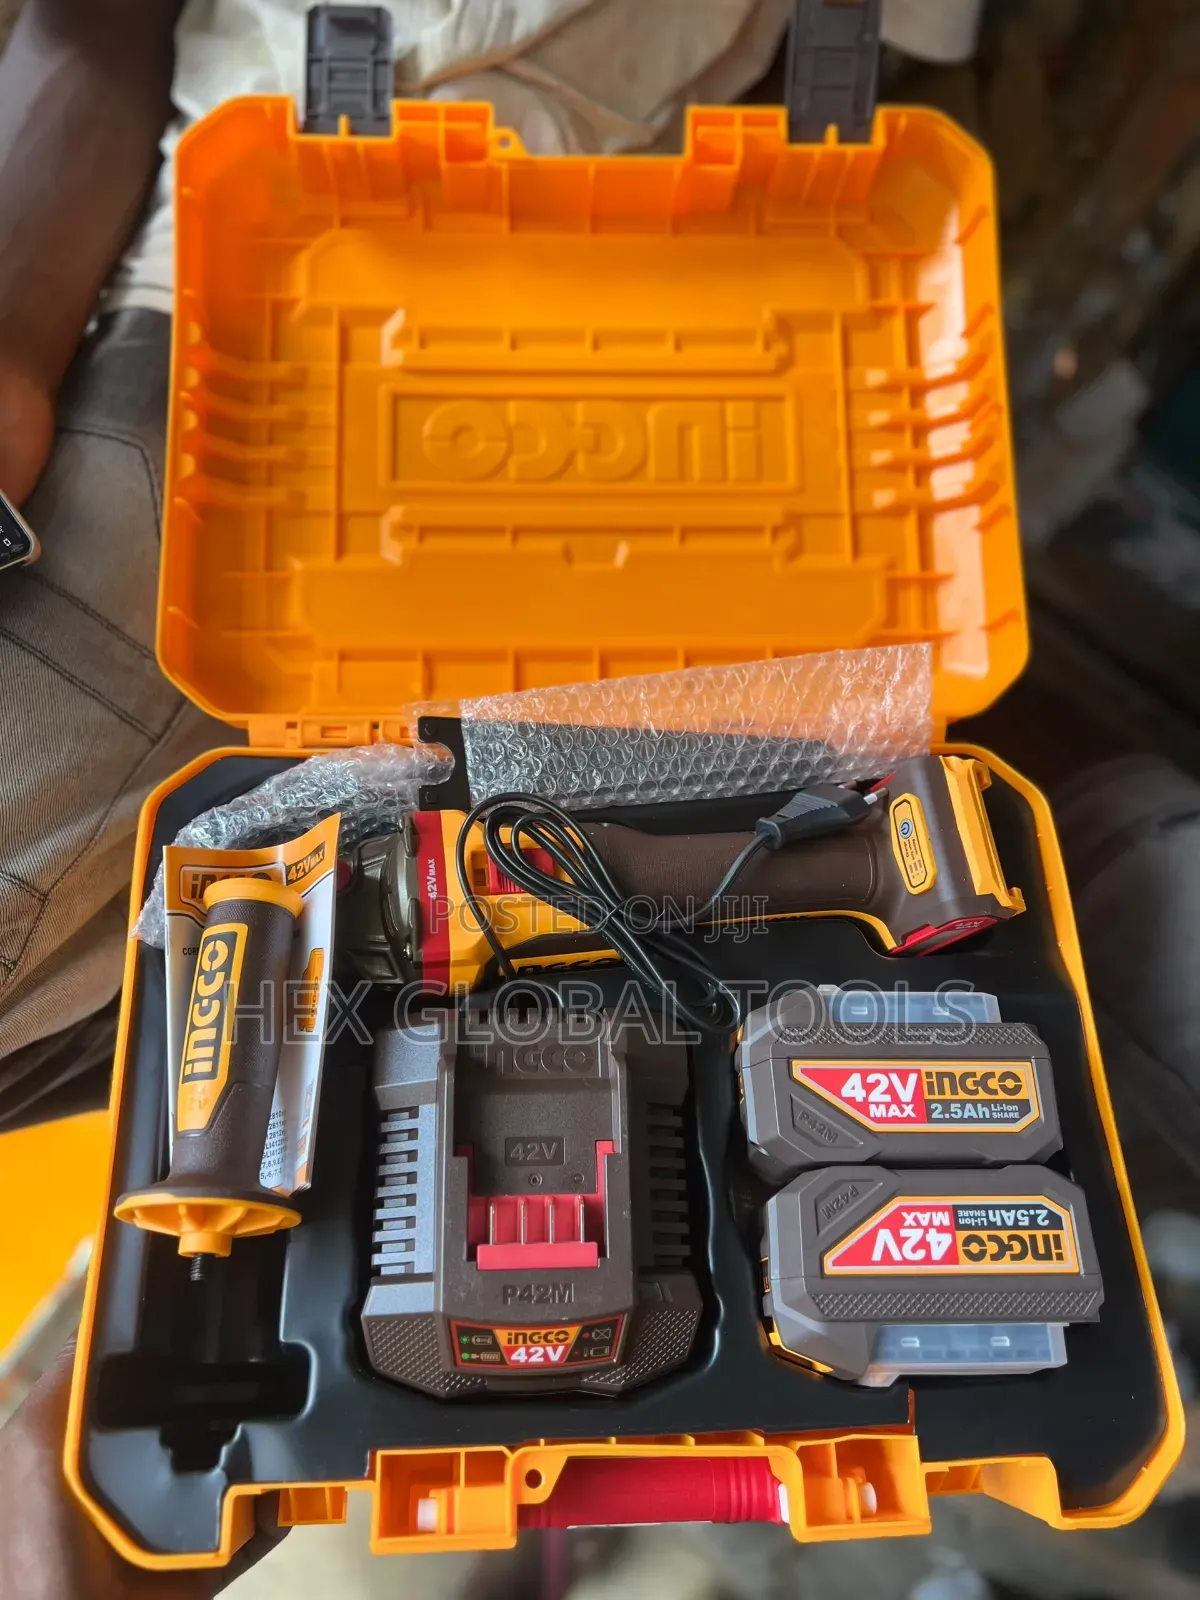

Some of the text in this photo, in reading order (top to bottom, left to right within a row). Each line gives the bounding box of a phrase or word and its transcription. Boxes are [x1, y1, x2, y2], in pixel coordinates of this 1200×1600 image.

[841, 1073, 918, 1102] 42V
[869, 1103, 917, 1118] MAX
[930, 1103, 990, 1119] 2.5Ah
[797, 1110, 838, 1143] P42M
[511, 1142, 557, 1160] 42V
[820, 1185, 859, 1219] P42M
[902, 1211, 950, 1226] MAX
[988, 1209, 1050, 1226] 2.5Ah
[872, 1228, 952, 1261] 42V
[502, 1283, 574, 1305] P42M
[510, 1345, 565, 1363] 42V
